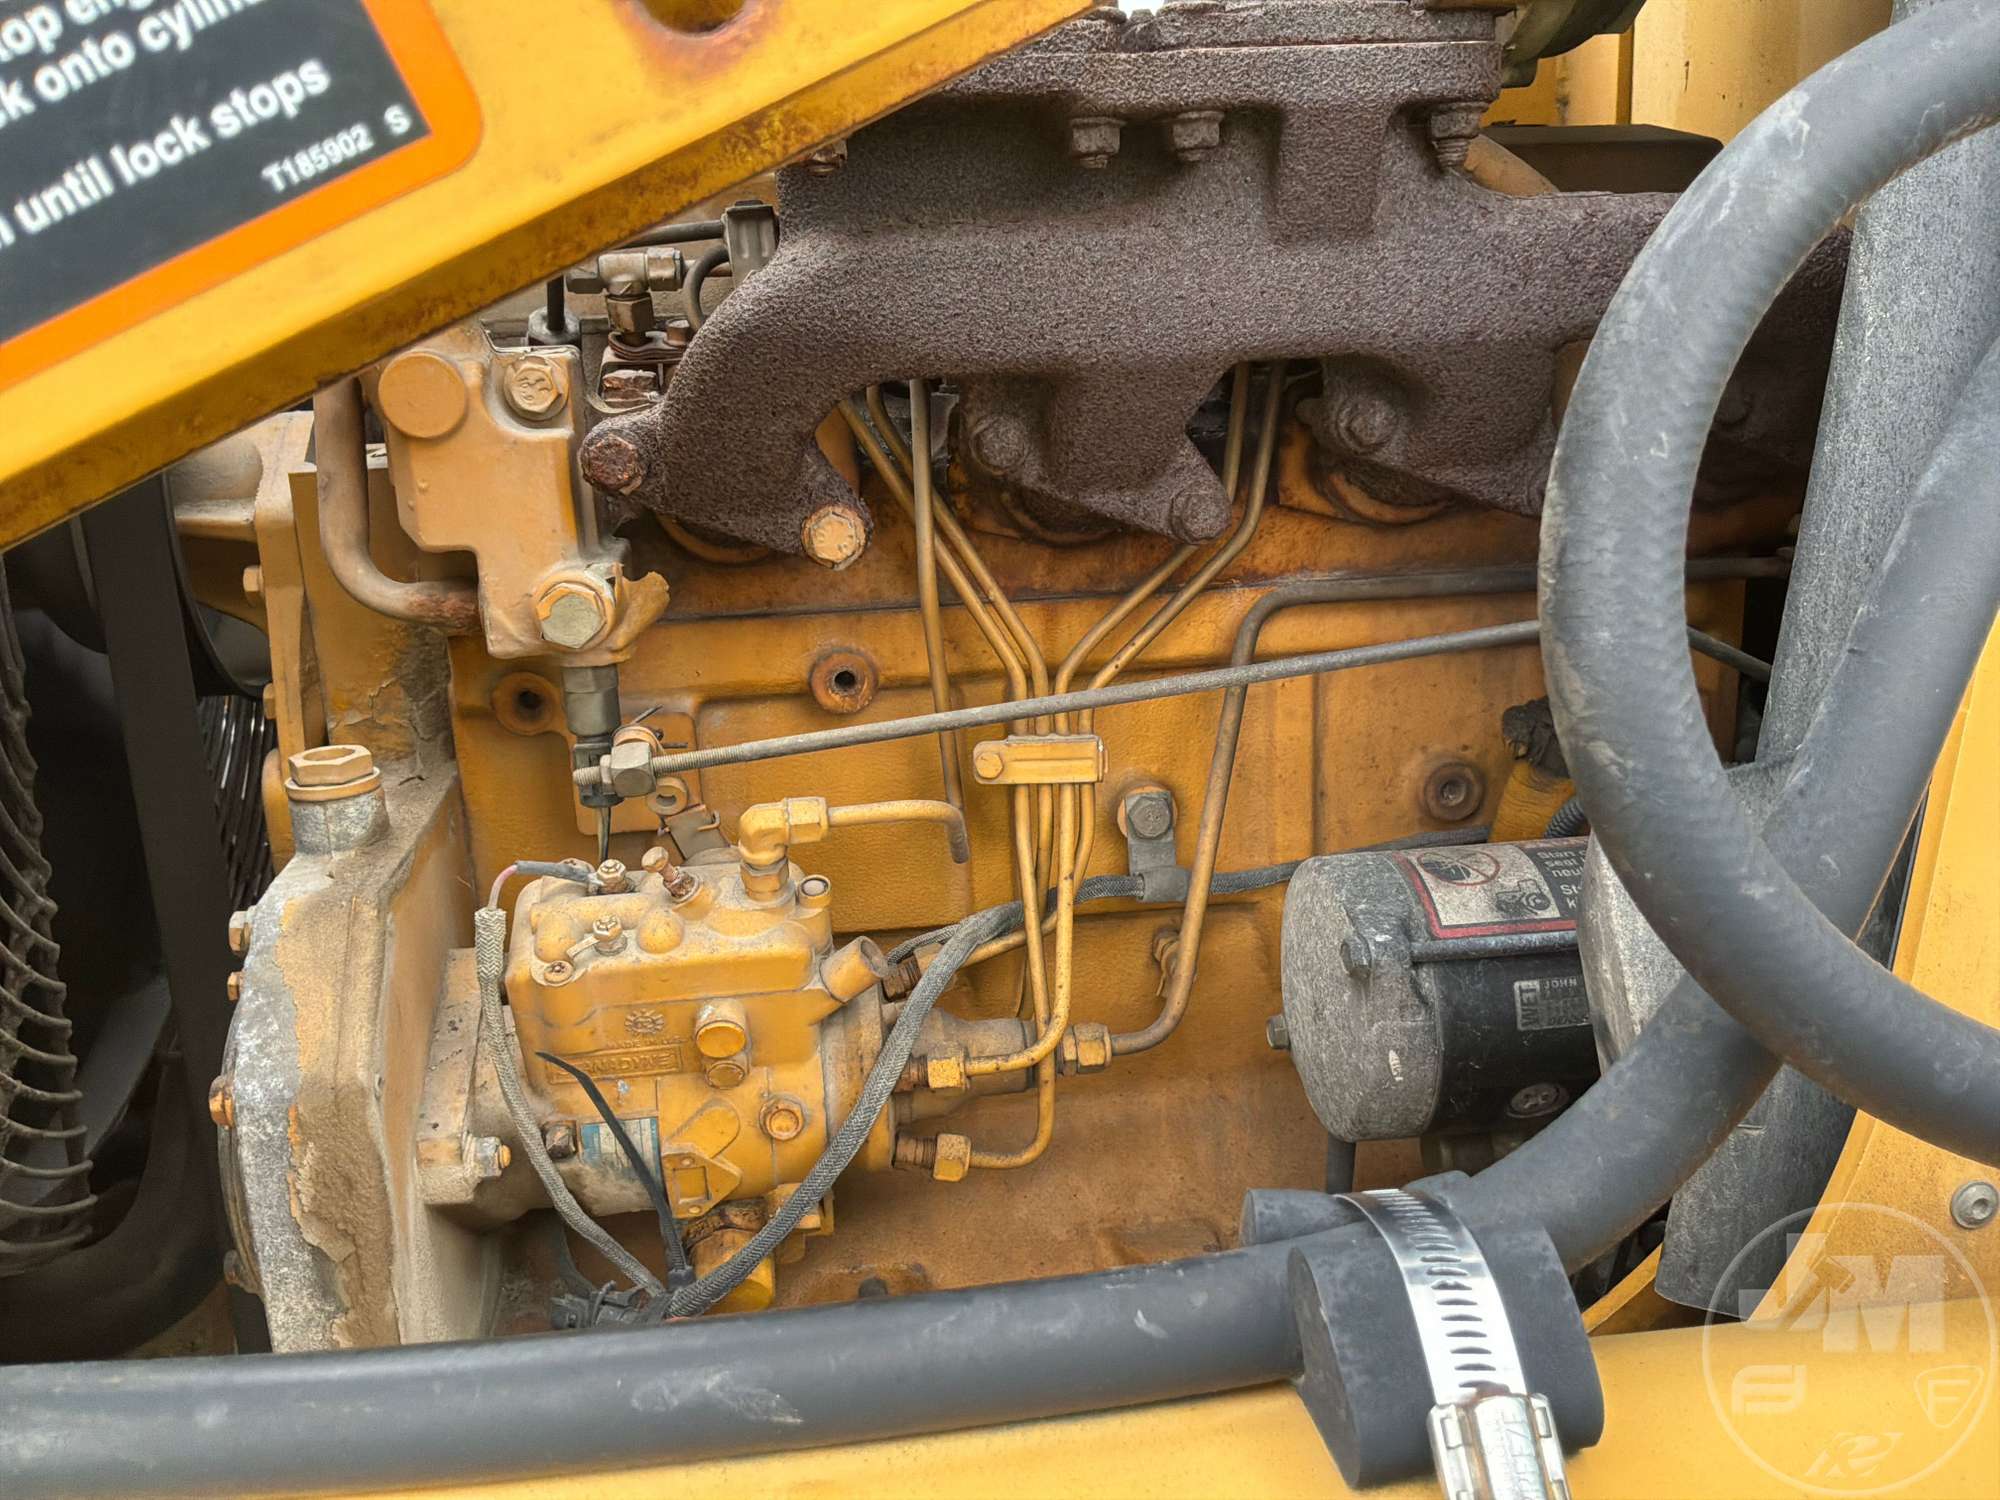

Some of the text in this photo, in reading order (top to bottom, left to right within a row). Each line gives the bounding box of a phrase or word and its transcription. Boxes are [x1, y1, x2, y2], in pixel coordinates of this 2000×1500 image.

[34, 31, 136, 102] onto
[15, 153, 115, 235] until
[111, 115, 211, 186] lock
[210, 58, 331, 139] stops
[261, 123, 374, 192] T185902
